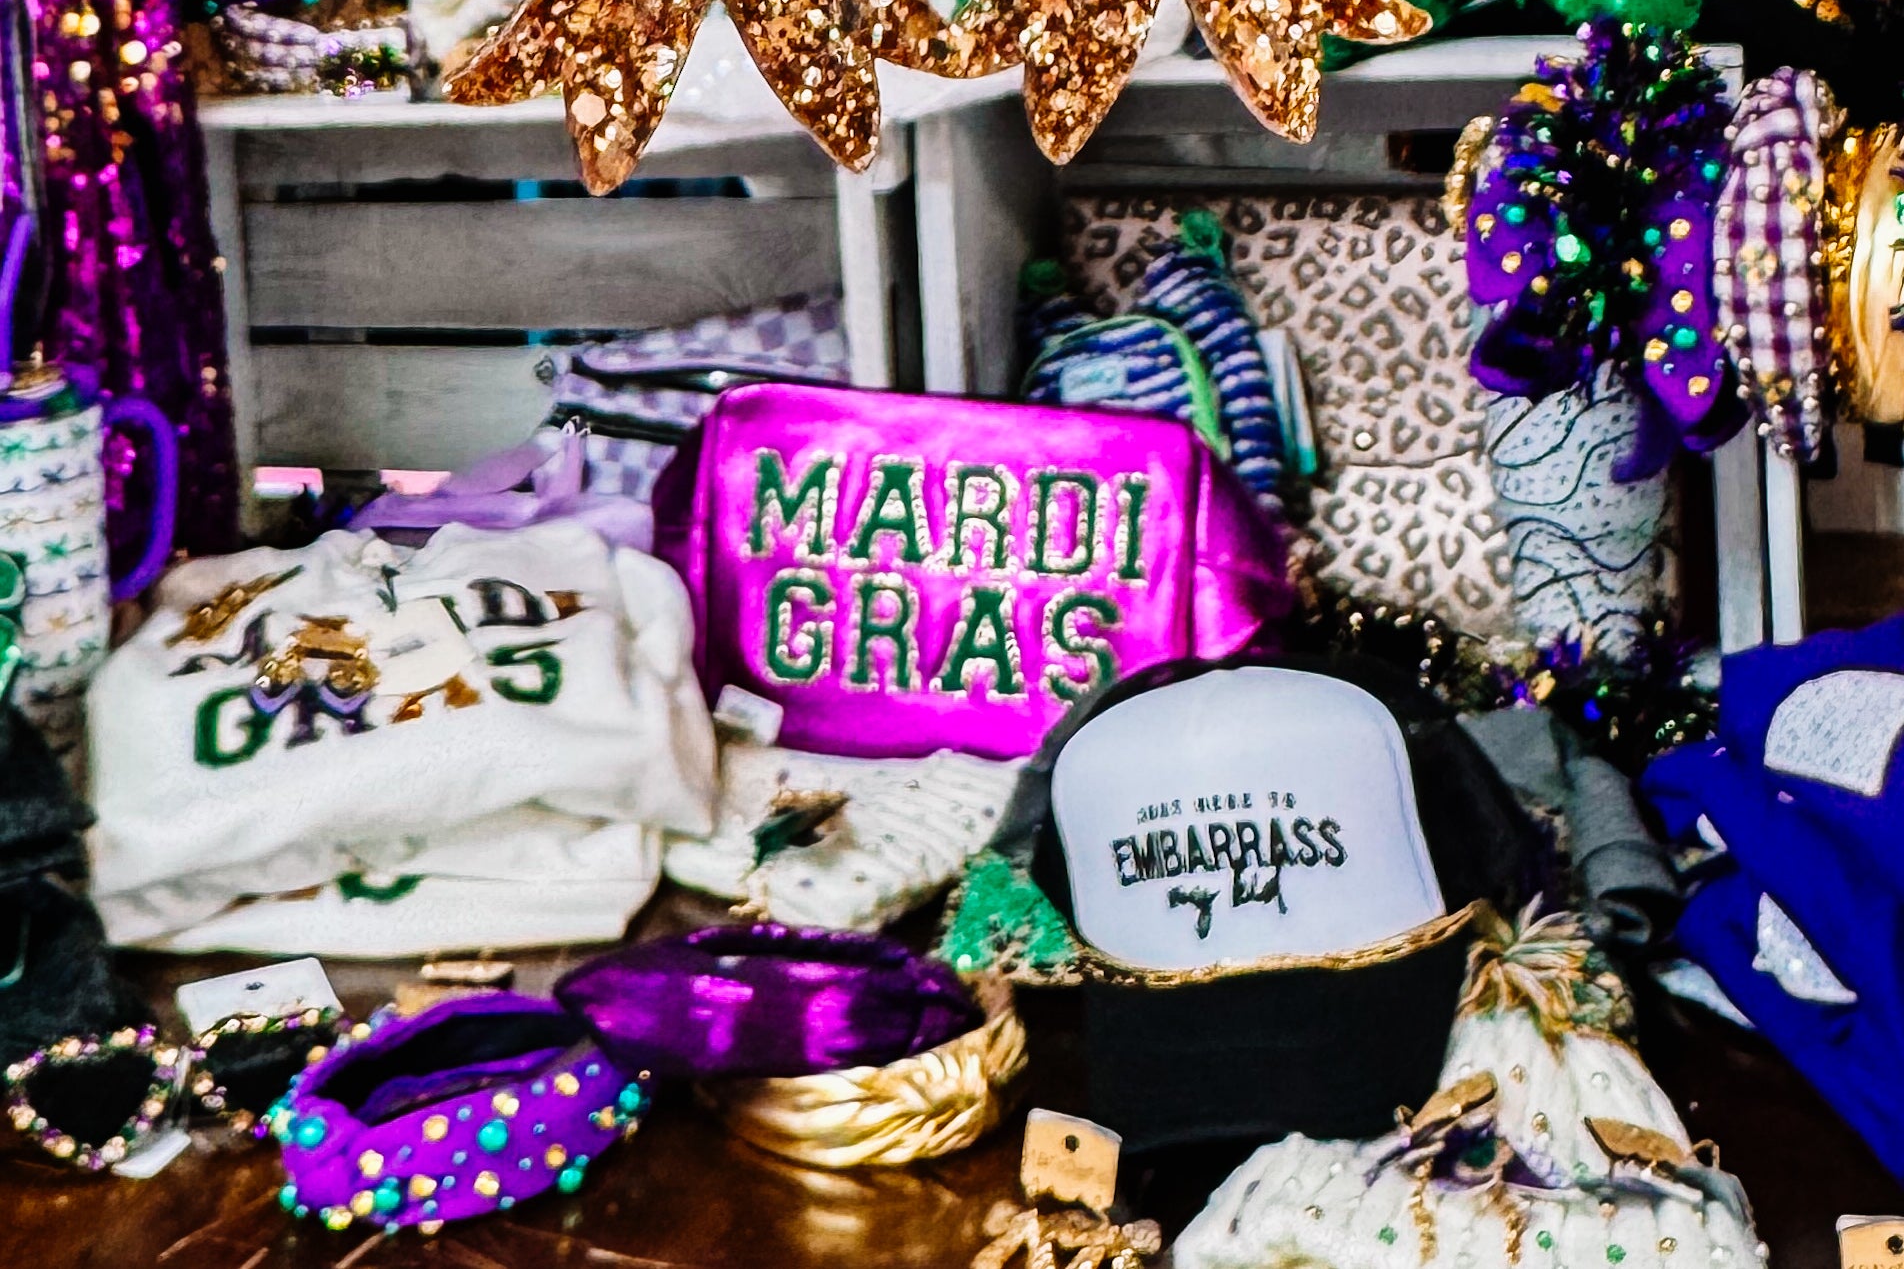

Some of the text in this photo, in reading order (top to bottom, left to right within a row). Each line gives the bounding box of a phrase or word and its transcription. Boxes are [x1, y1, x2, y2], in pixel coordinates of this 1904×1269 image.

[738, 445, 1152, 589] MARDI
[761, 567, 1123, 707] GRAS
[1110, 815, 1348, 886] EMBARRASS
